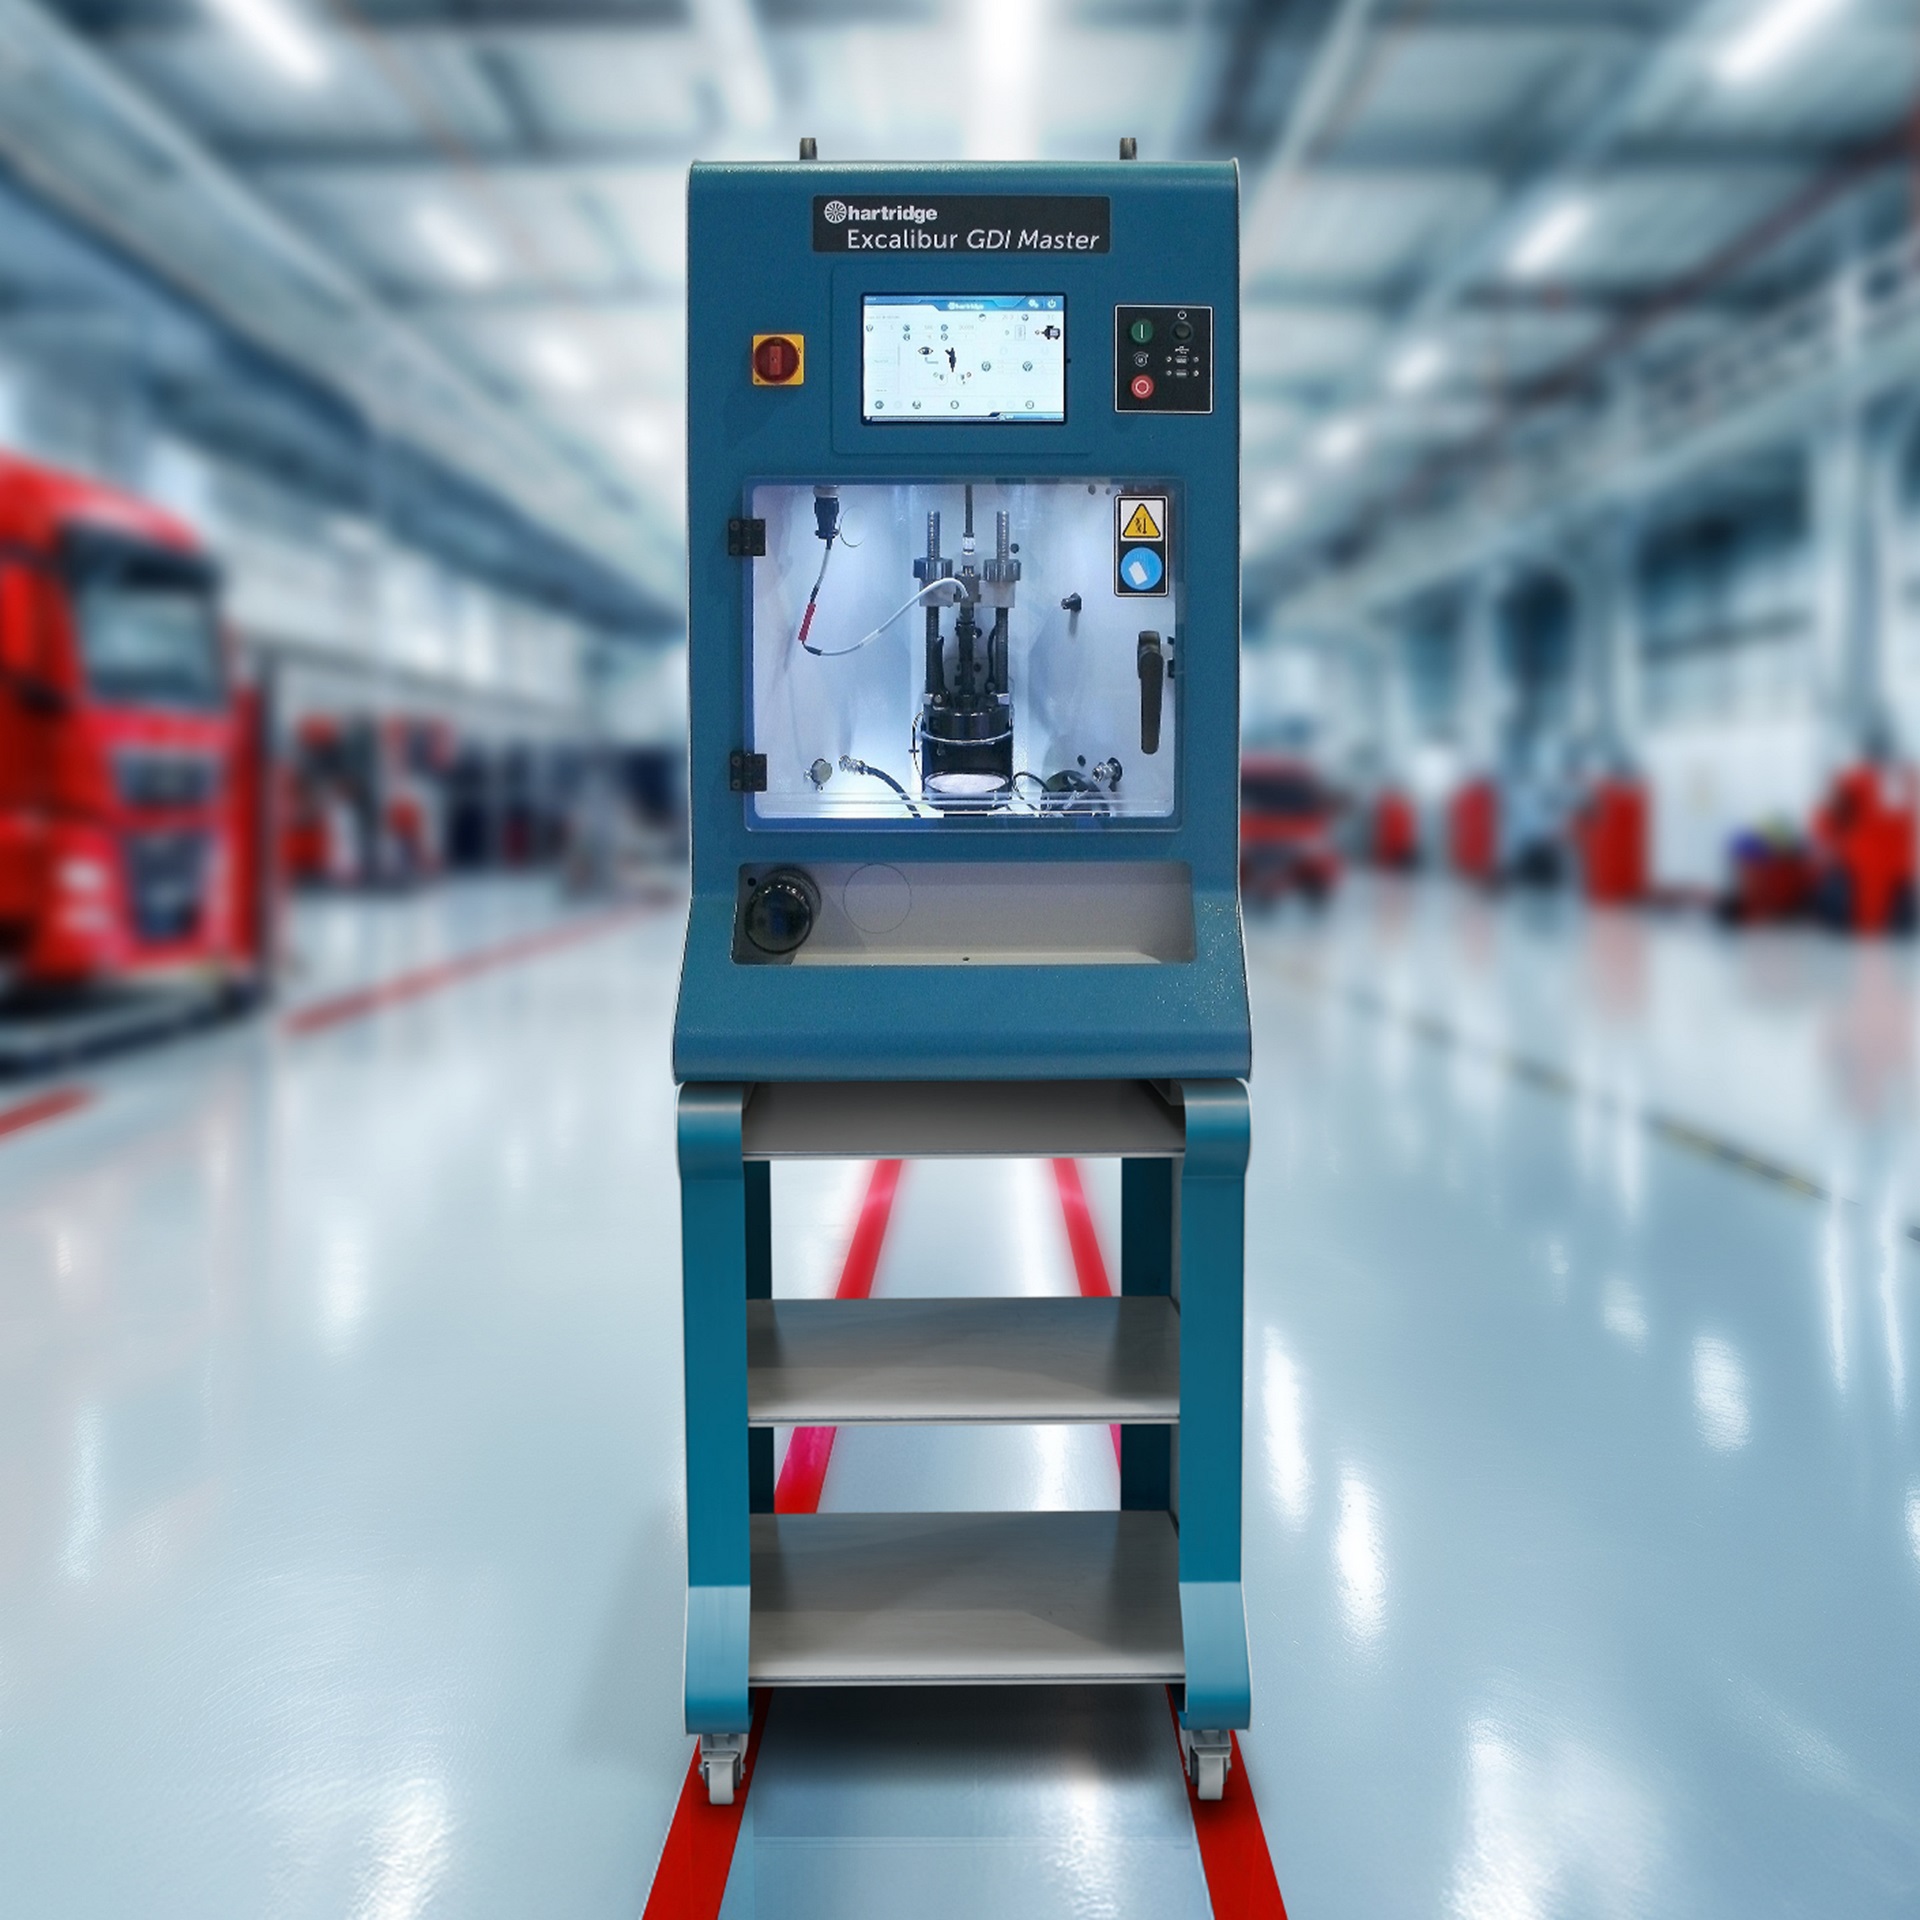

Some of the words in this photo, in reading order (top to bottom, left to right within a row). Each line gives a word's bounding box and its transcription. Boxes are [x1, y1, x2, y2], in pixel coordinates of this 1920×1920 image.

[848, 205, 938, 224] hartridge
[847, 229, 958, 249] Excalibur
[966, 229, 1011, 249] GDI
[1017, 229, 1100, 250] Master
